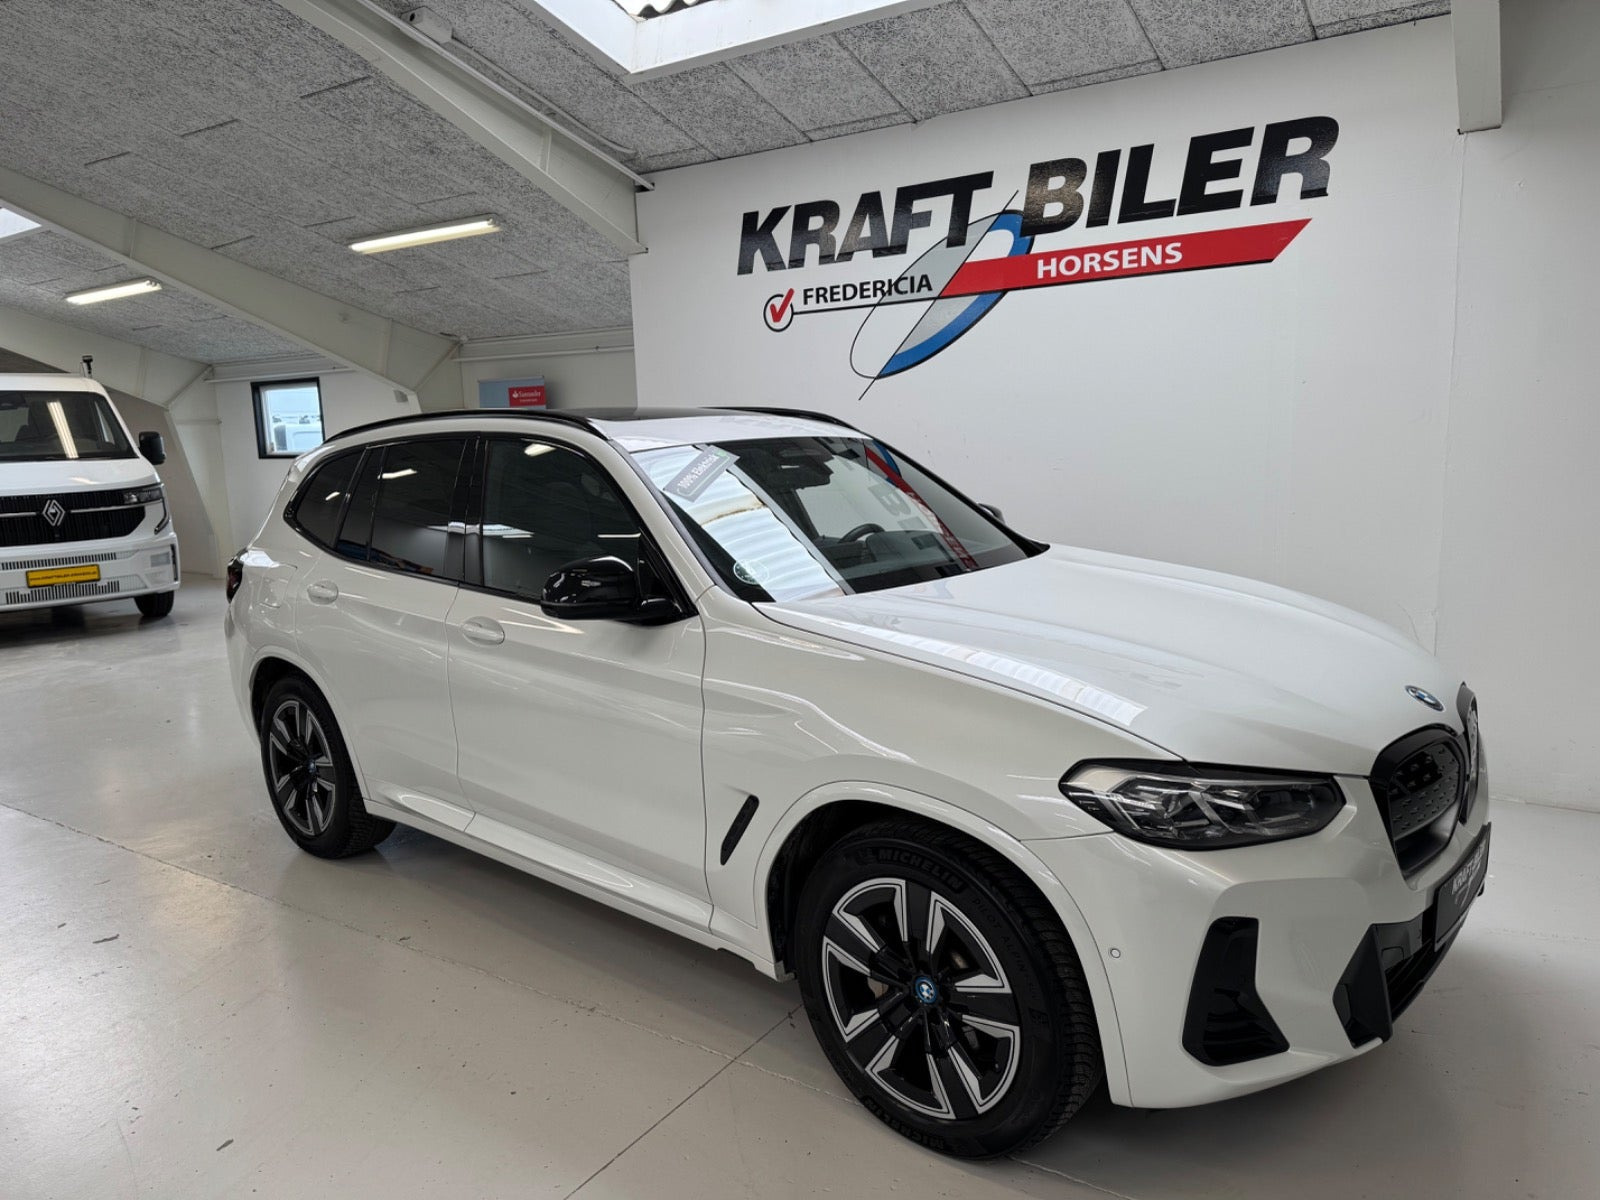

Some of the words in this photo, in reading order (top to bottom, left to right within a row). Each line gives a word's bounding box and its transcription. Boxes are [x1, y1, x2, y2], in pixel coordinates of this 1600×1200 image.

[737, 171, 994, 276] KRAFT
[1020, 115, 1339, 237] BILER
[1036, 242, 1183, 279] HORSENS
[802, 273, 933, 306] FREDERICIA
[879, 848, 963, 889] MICHELIN
